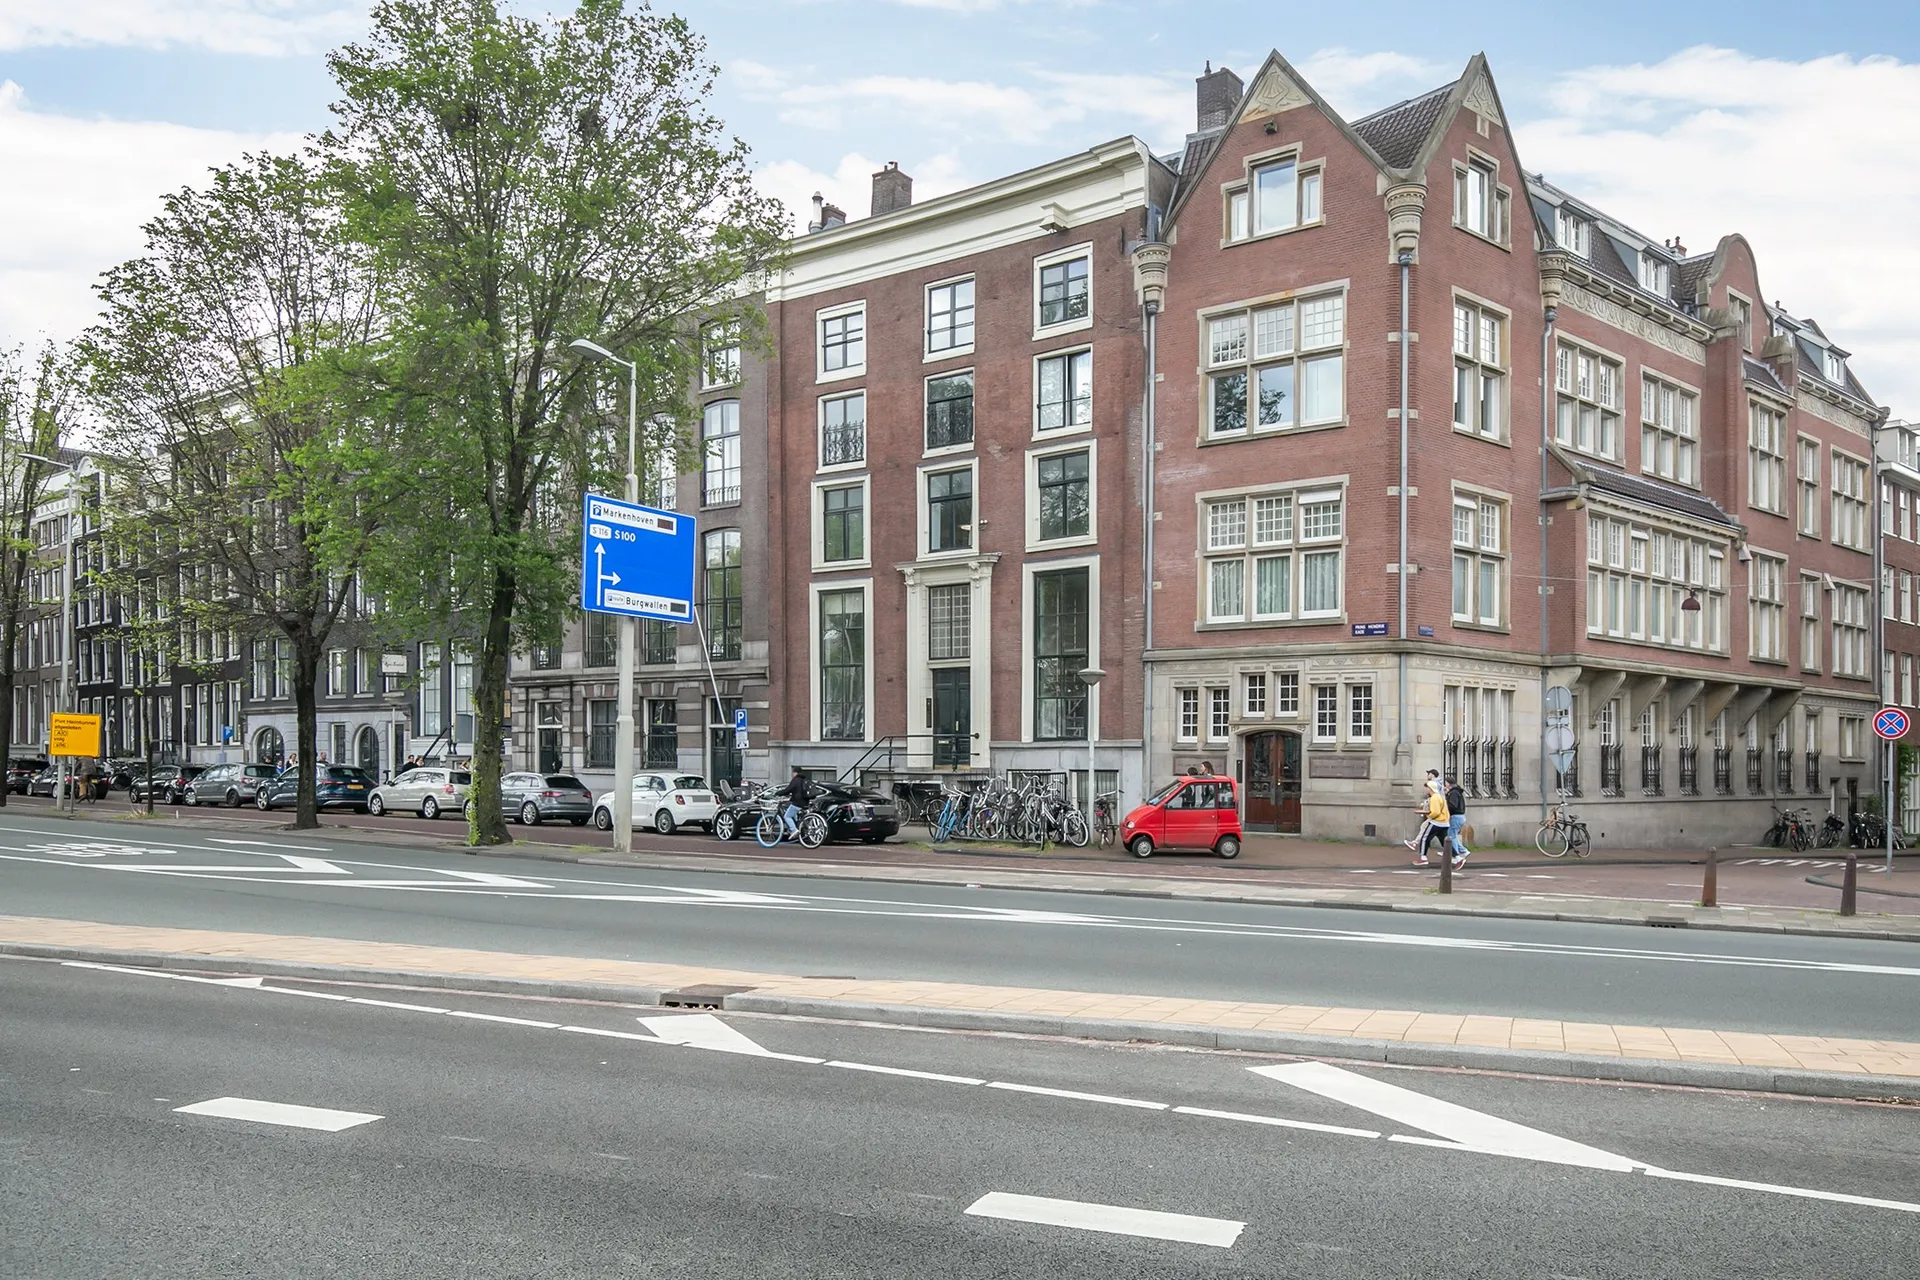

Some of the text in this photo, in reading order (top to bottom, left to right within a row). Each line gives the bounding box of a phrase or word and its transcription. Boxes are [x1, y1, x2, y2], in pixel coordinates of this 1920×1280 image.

[603, 507, 654, 525] Markenhoven
[614, 529, 636, 542] S100
[626, 596, 668, 610] Burgwallen
[738, 711, 745, 723] P
